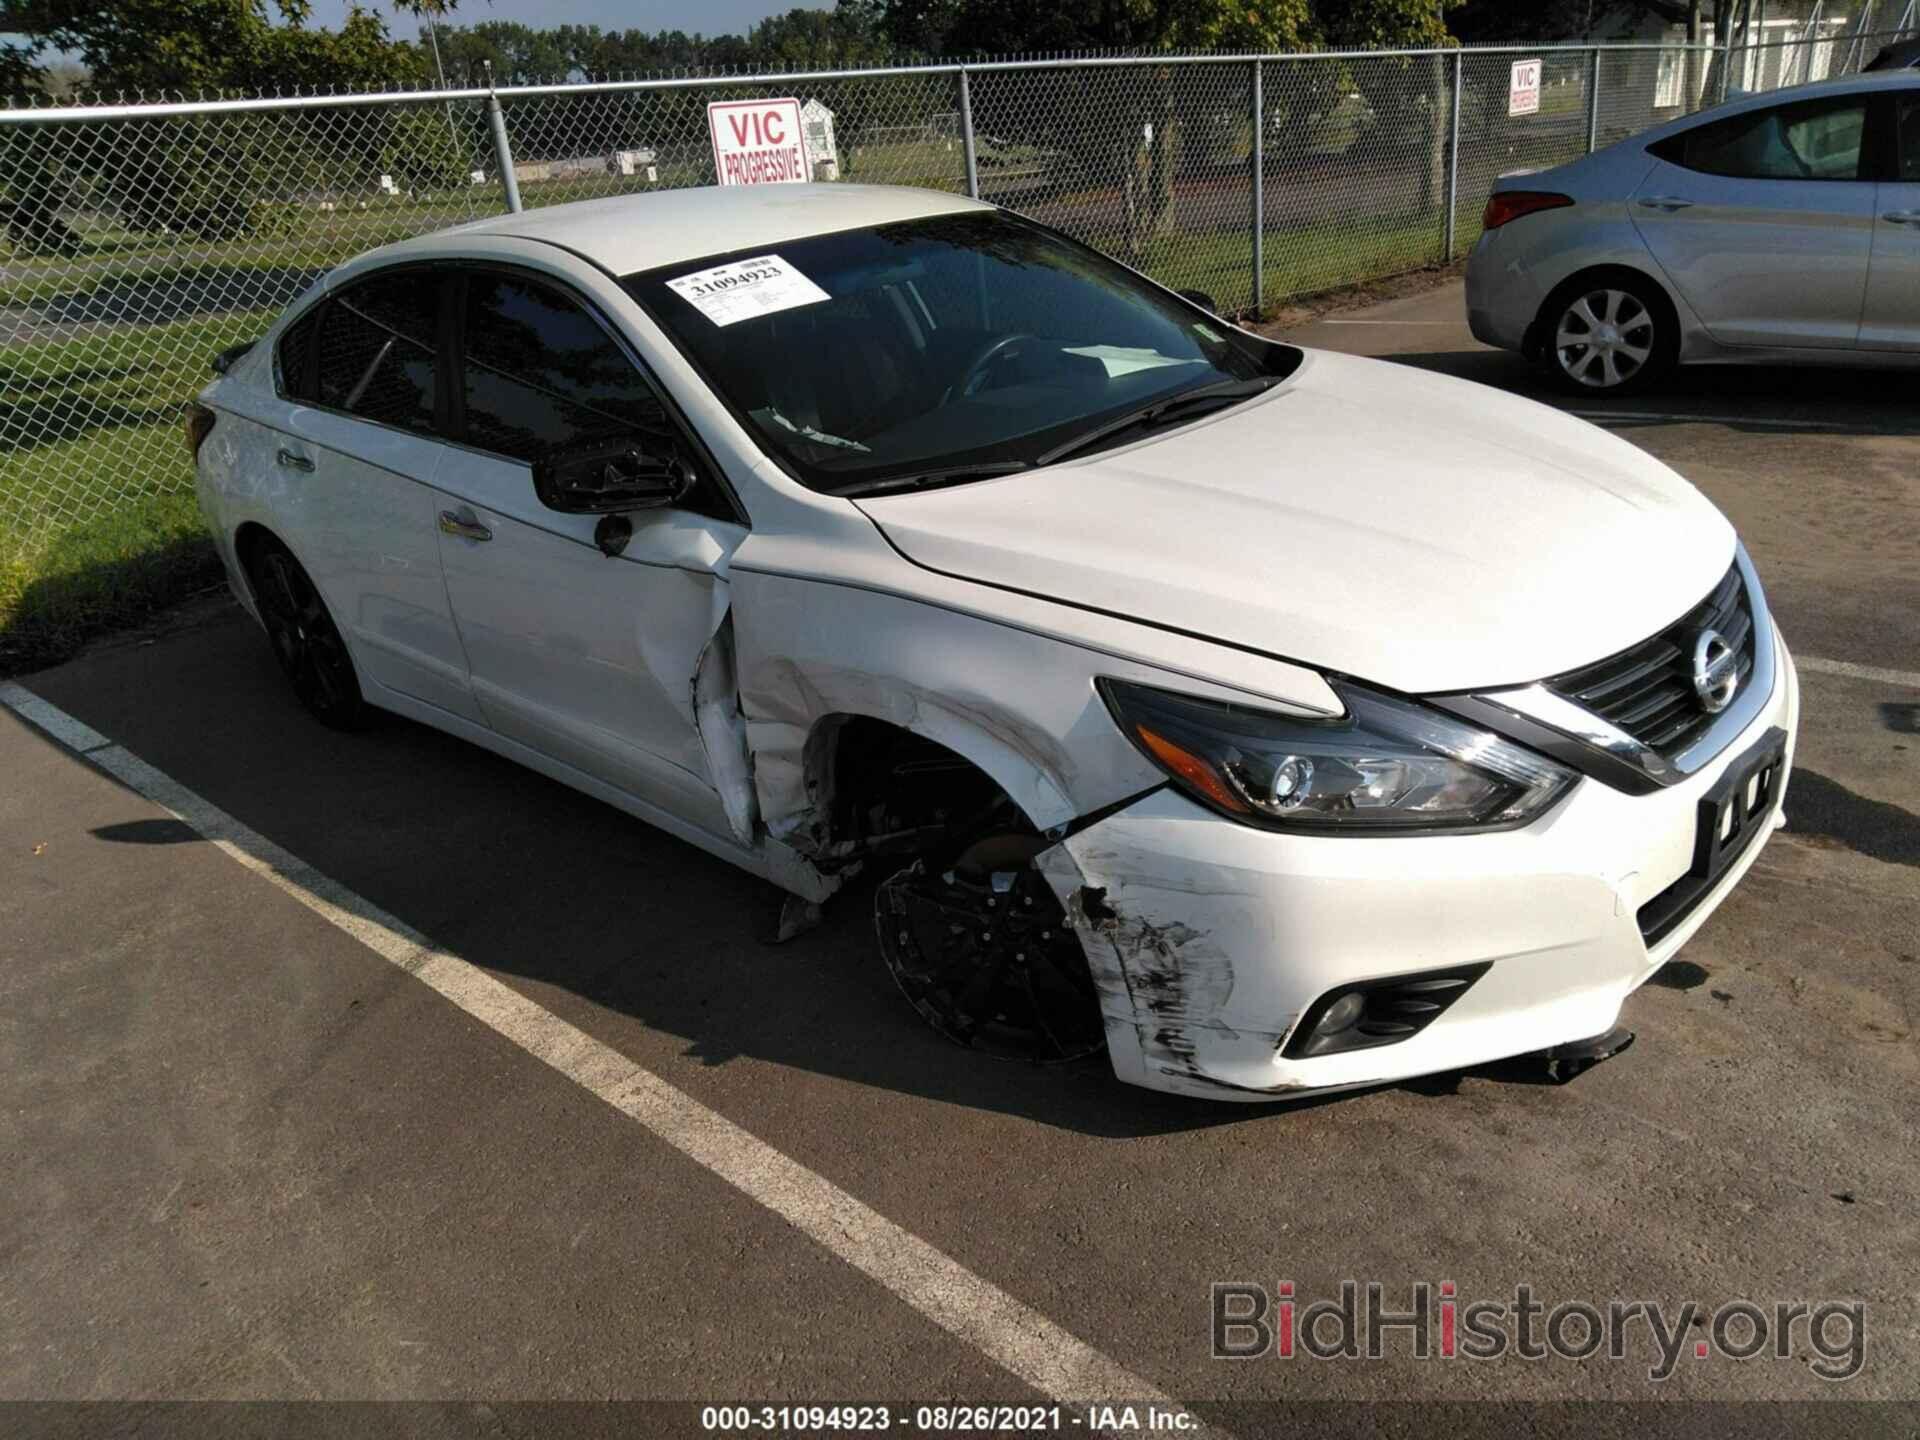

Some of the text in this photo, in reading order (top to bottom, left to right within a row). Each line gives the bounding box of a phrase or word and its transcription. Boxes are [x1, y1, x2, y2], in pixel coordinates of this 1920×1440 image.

[1517, 67, 1535, 88] VIC
[728, 111, 785, 147] VIC
[724, 147, 802, 184] PROGRESSIVE
[690, 266, 783, 297] 31094923
